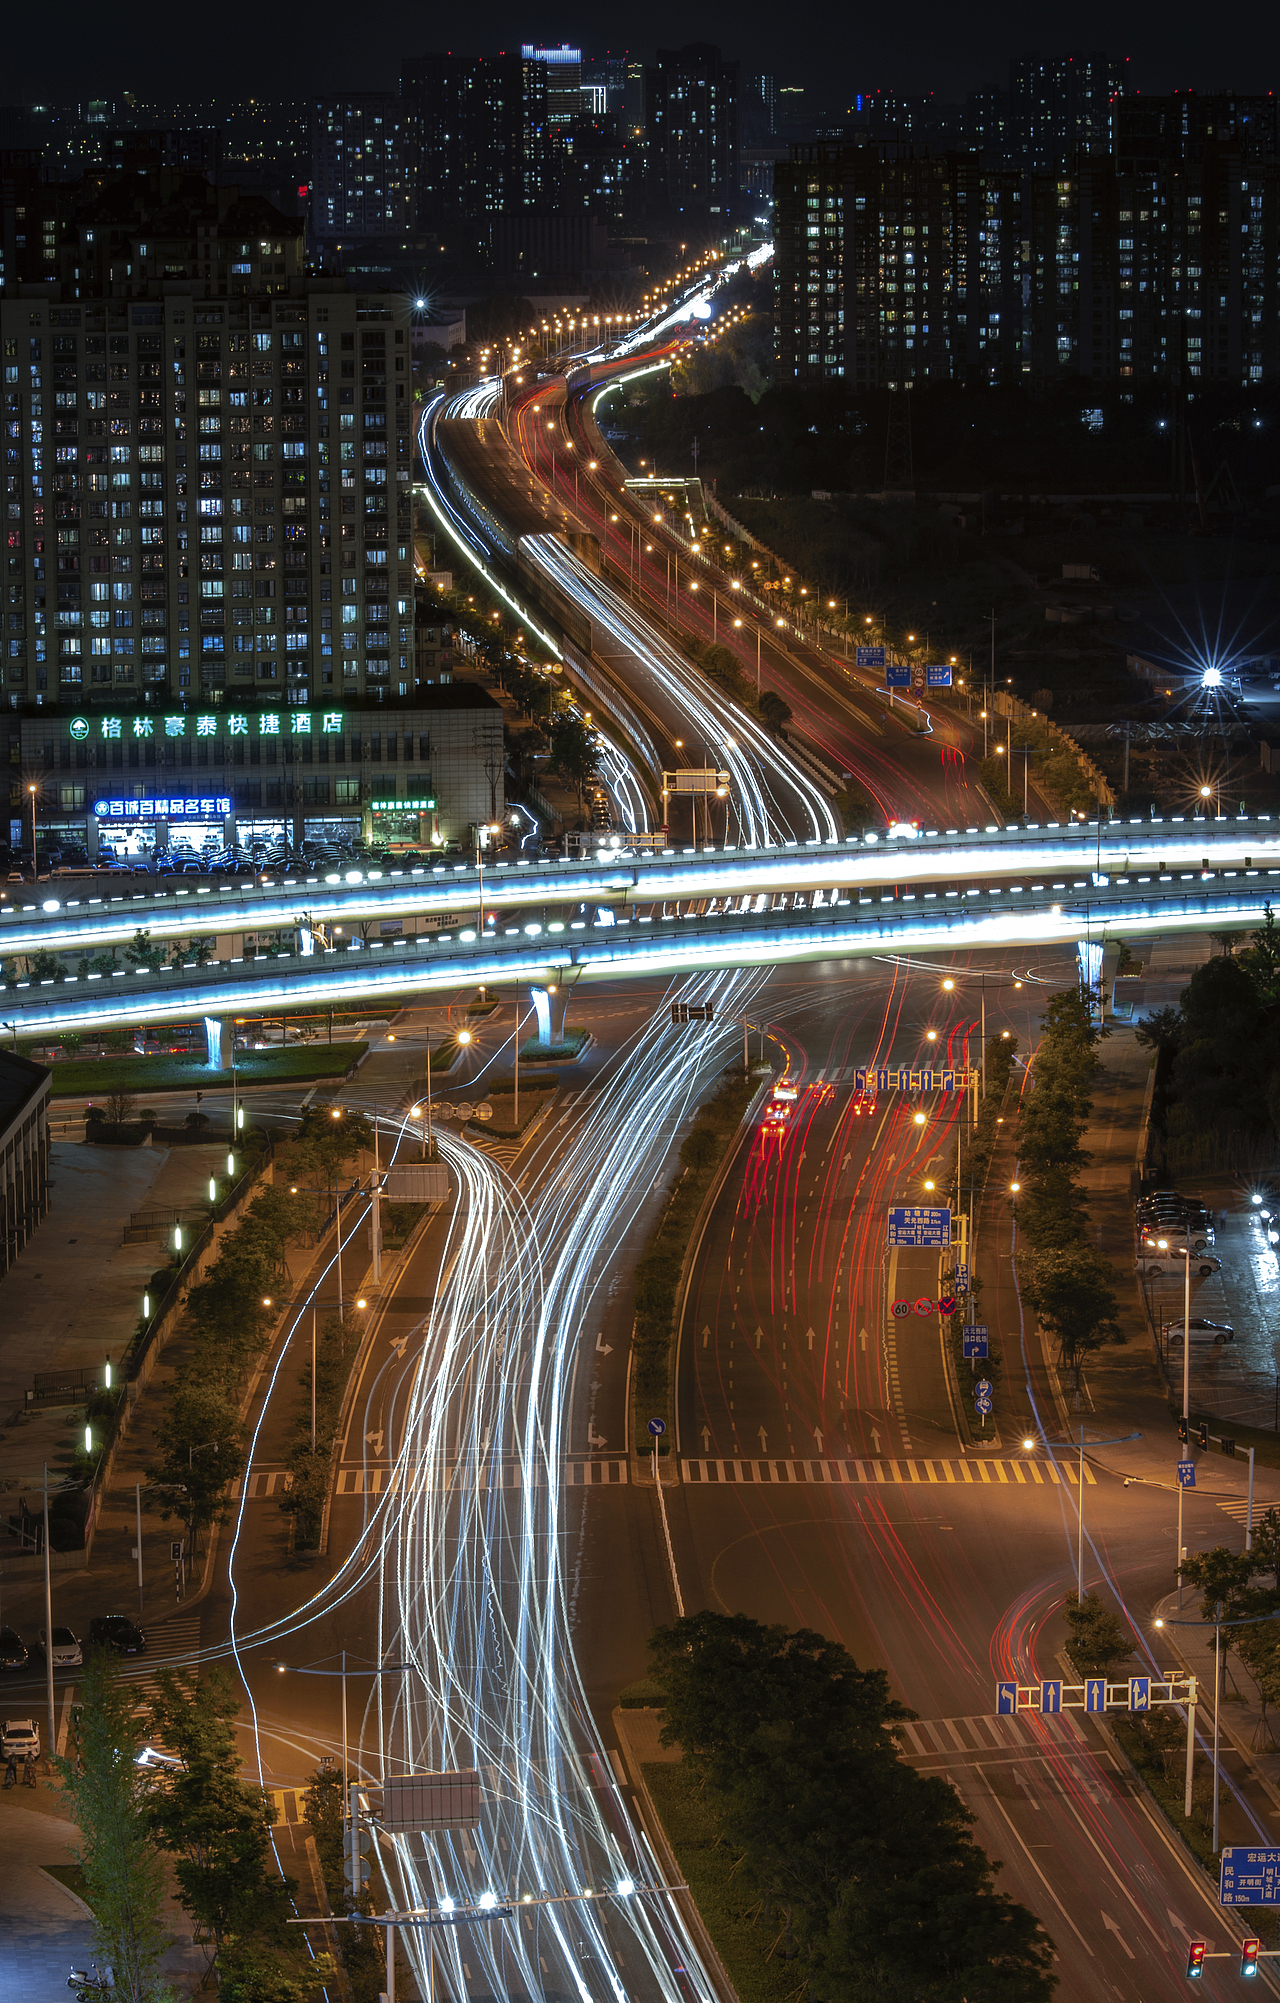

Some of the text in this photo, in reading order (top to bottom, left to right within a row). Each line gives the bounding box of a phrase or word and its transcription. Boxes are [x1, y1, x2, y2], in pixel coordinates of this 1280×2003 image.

[101, 712, 343, 738] 格林豪泰快捷酒店
[109, 798, 231, 815] 百诚百精品名车馆
[895, 1304, 907, 1314] 60
[1223, 1866, 1234, 1902] 民和路
[1265, 1868, 1274, 1898] 明城大道
[1235, 1894, 1250, 1902] 150m
